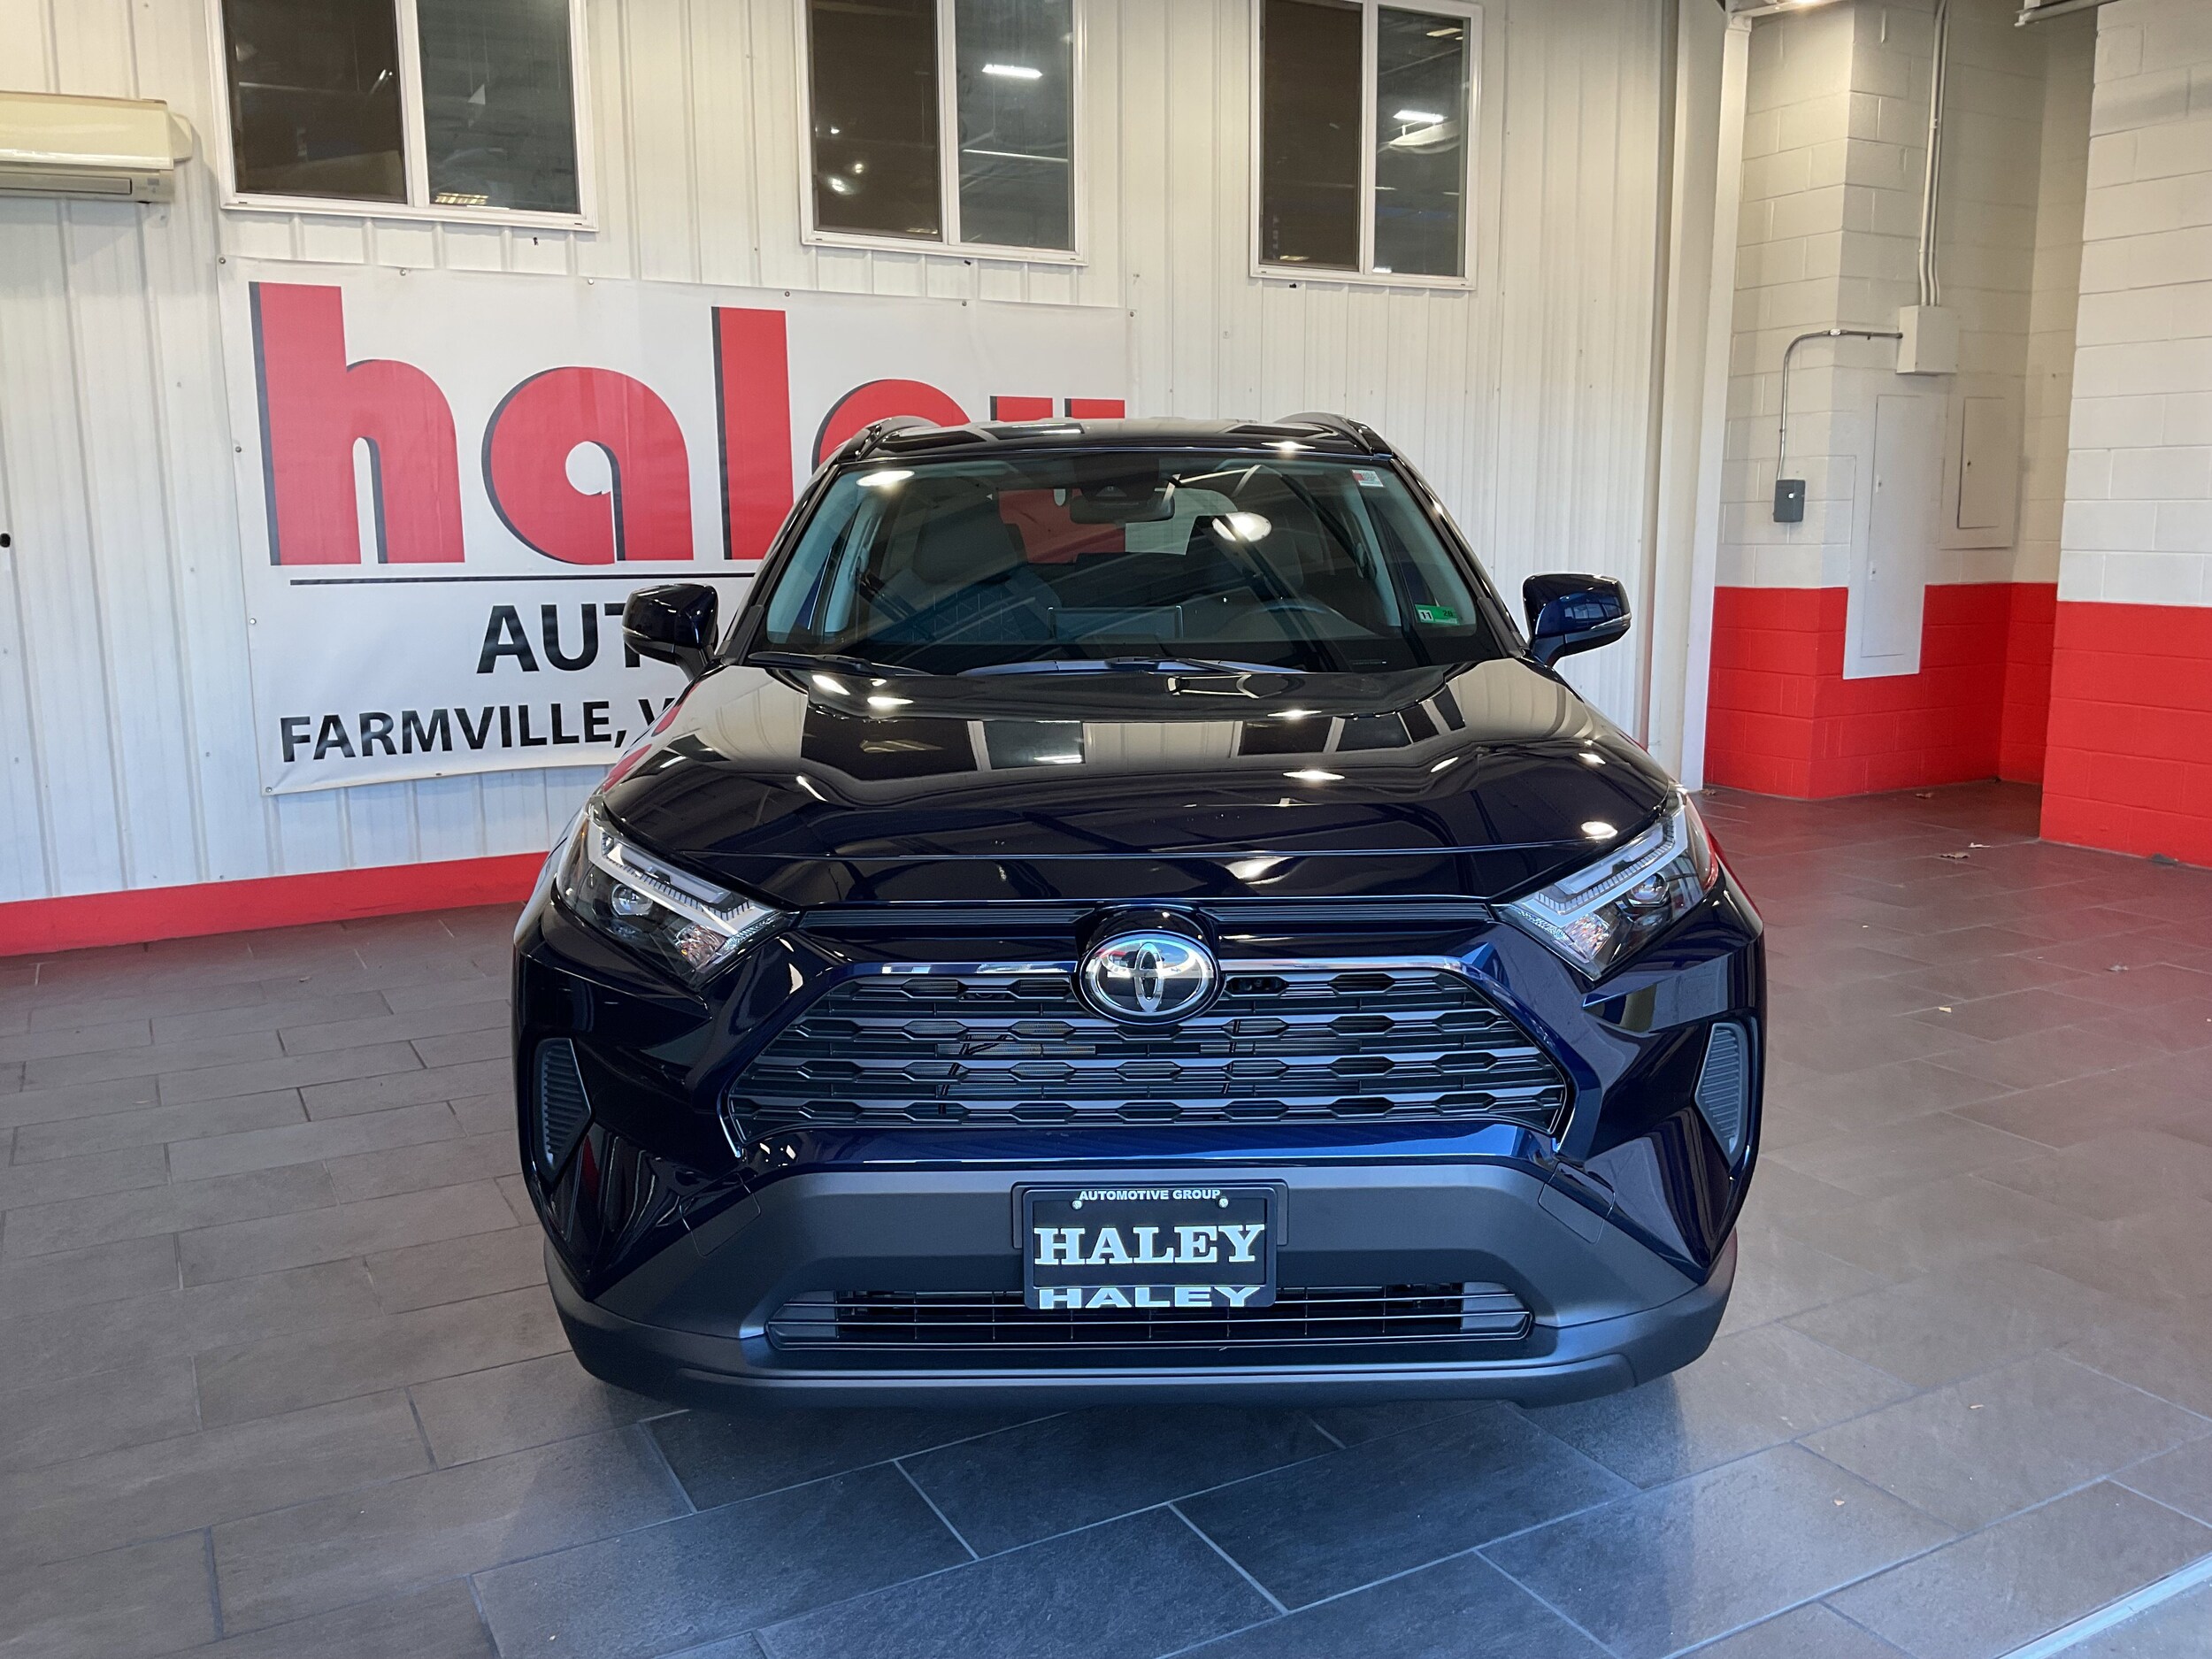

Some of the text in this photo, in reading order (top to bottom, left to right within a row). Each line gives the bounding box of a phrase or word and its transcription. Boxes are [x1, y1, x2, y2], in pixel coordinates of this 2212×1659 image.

[249, 282, 1125, 565] hal
[280, 700, 627, 763] FARMVILLE,
[1079, 1188, 1221, 1201] AUTOMOTIVE GROUP
[1033, 1224, 1265, 1265] HALEY
[1039, 1286, 1261, 1310] HALEY
